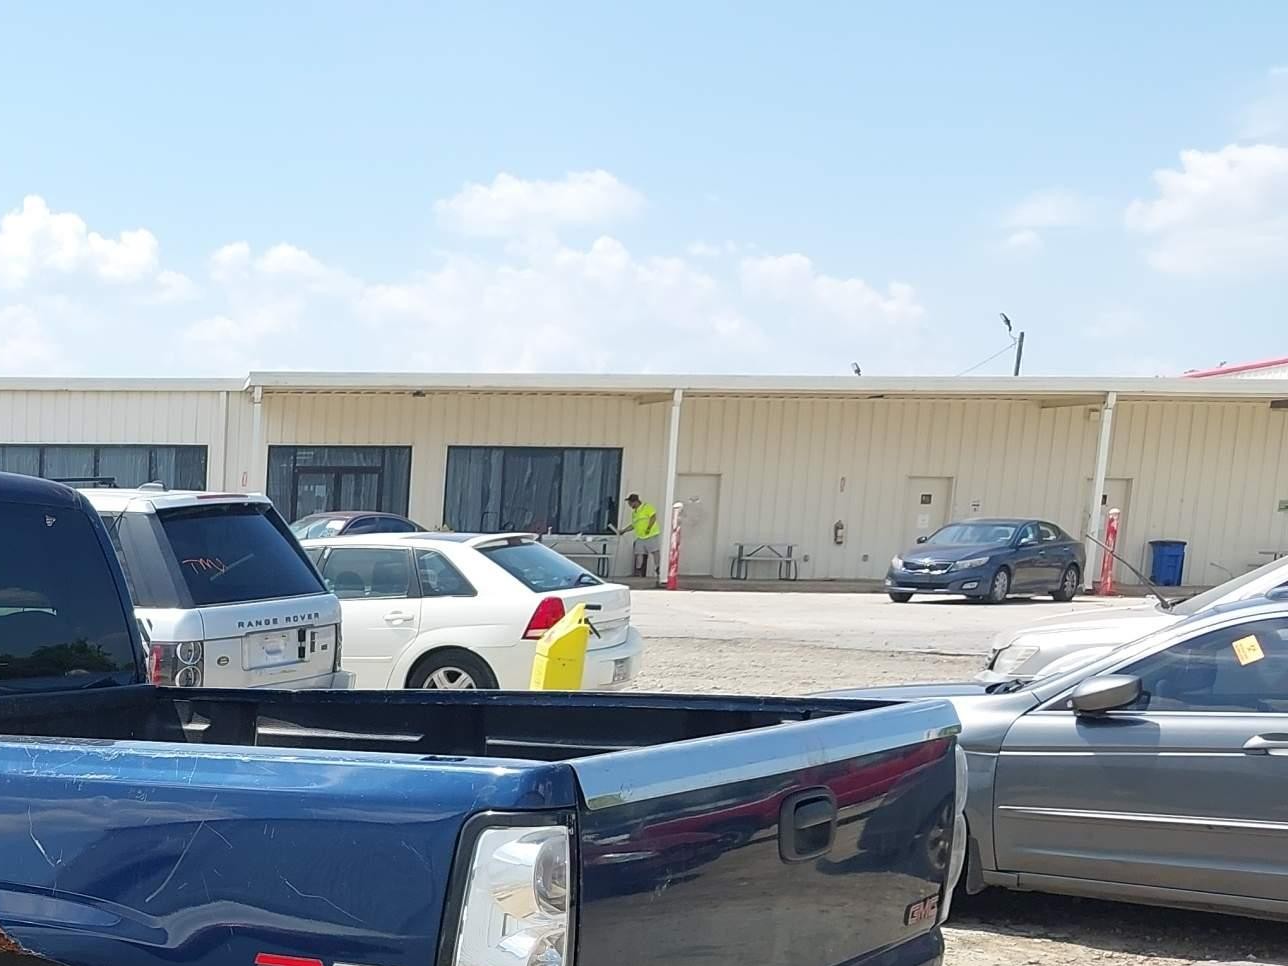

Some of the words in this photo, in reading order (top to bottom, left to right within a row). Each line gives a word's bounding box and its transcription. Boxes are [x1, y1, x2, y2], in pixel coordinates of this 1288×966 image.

[237, 617, 279, 629] RANGE
[285, 612, 320, 624] ROVER
[908, 895, 940, 925] GMC
